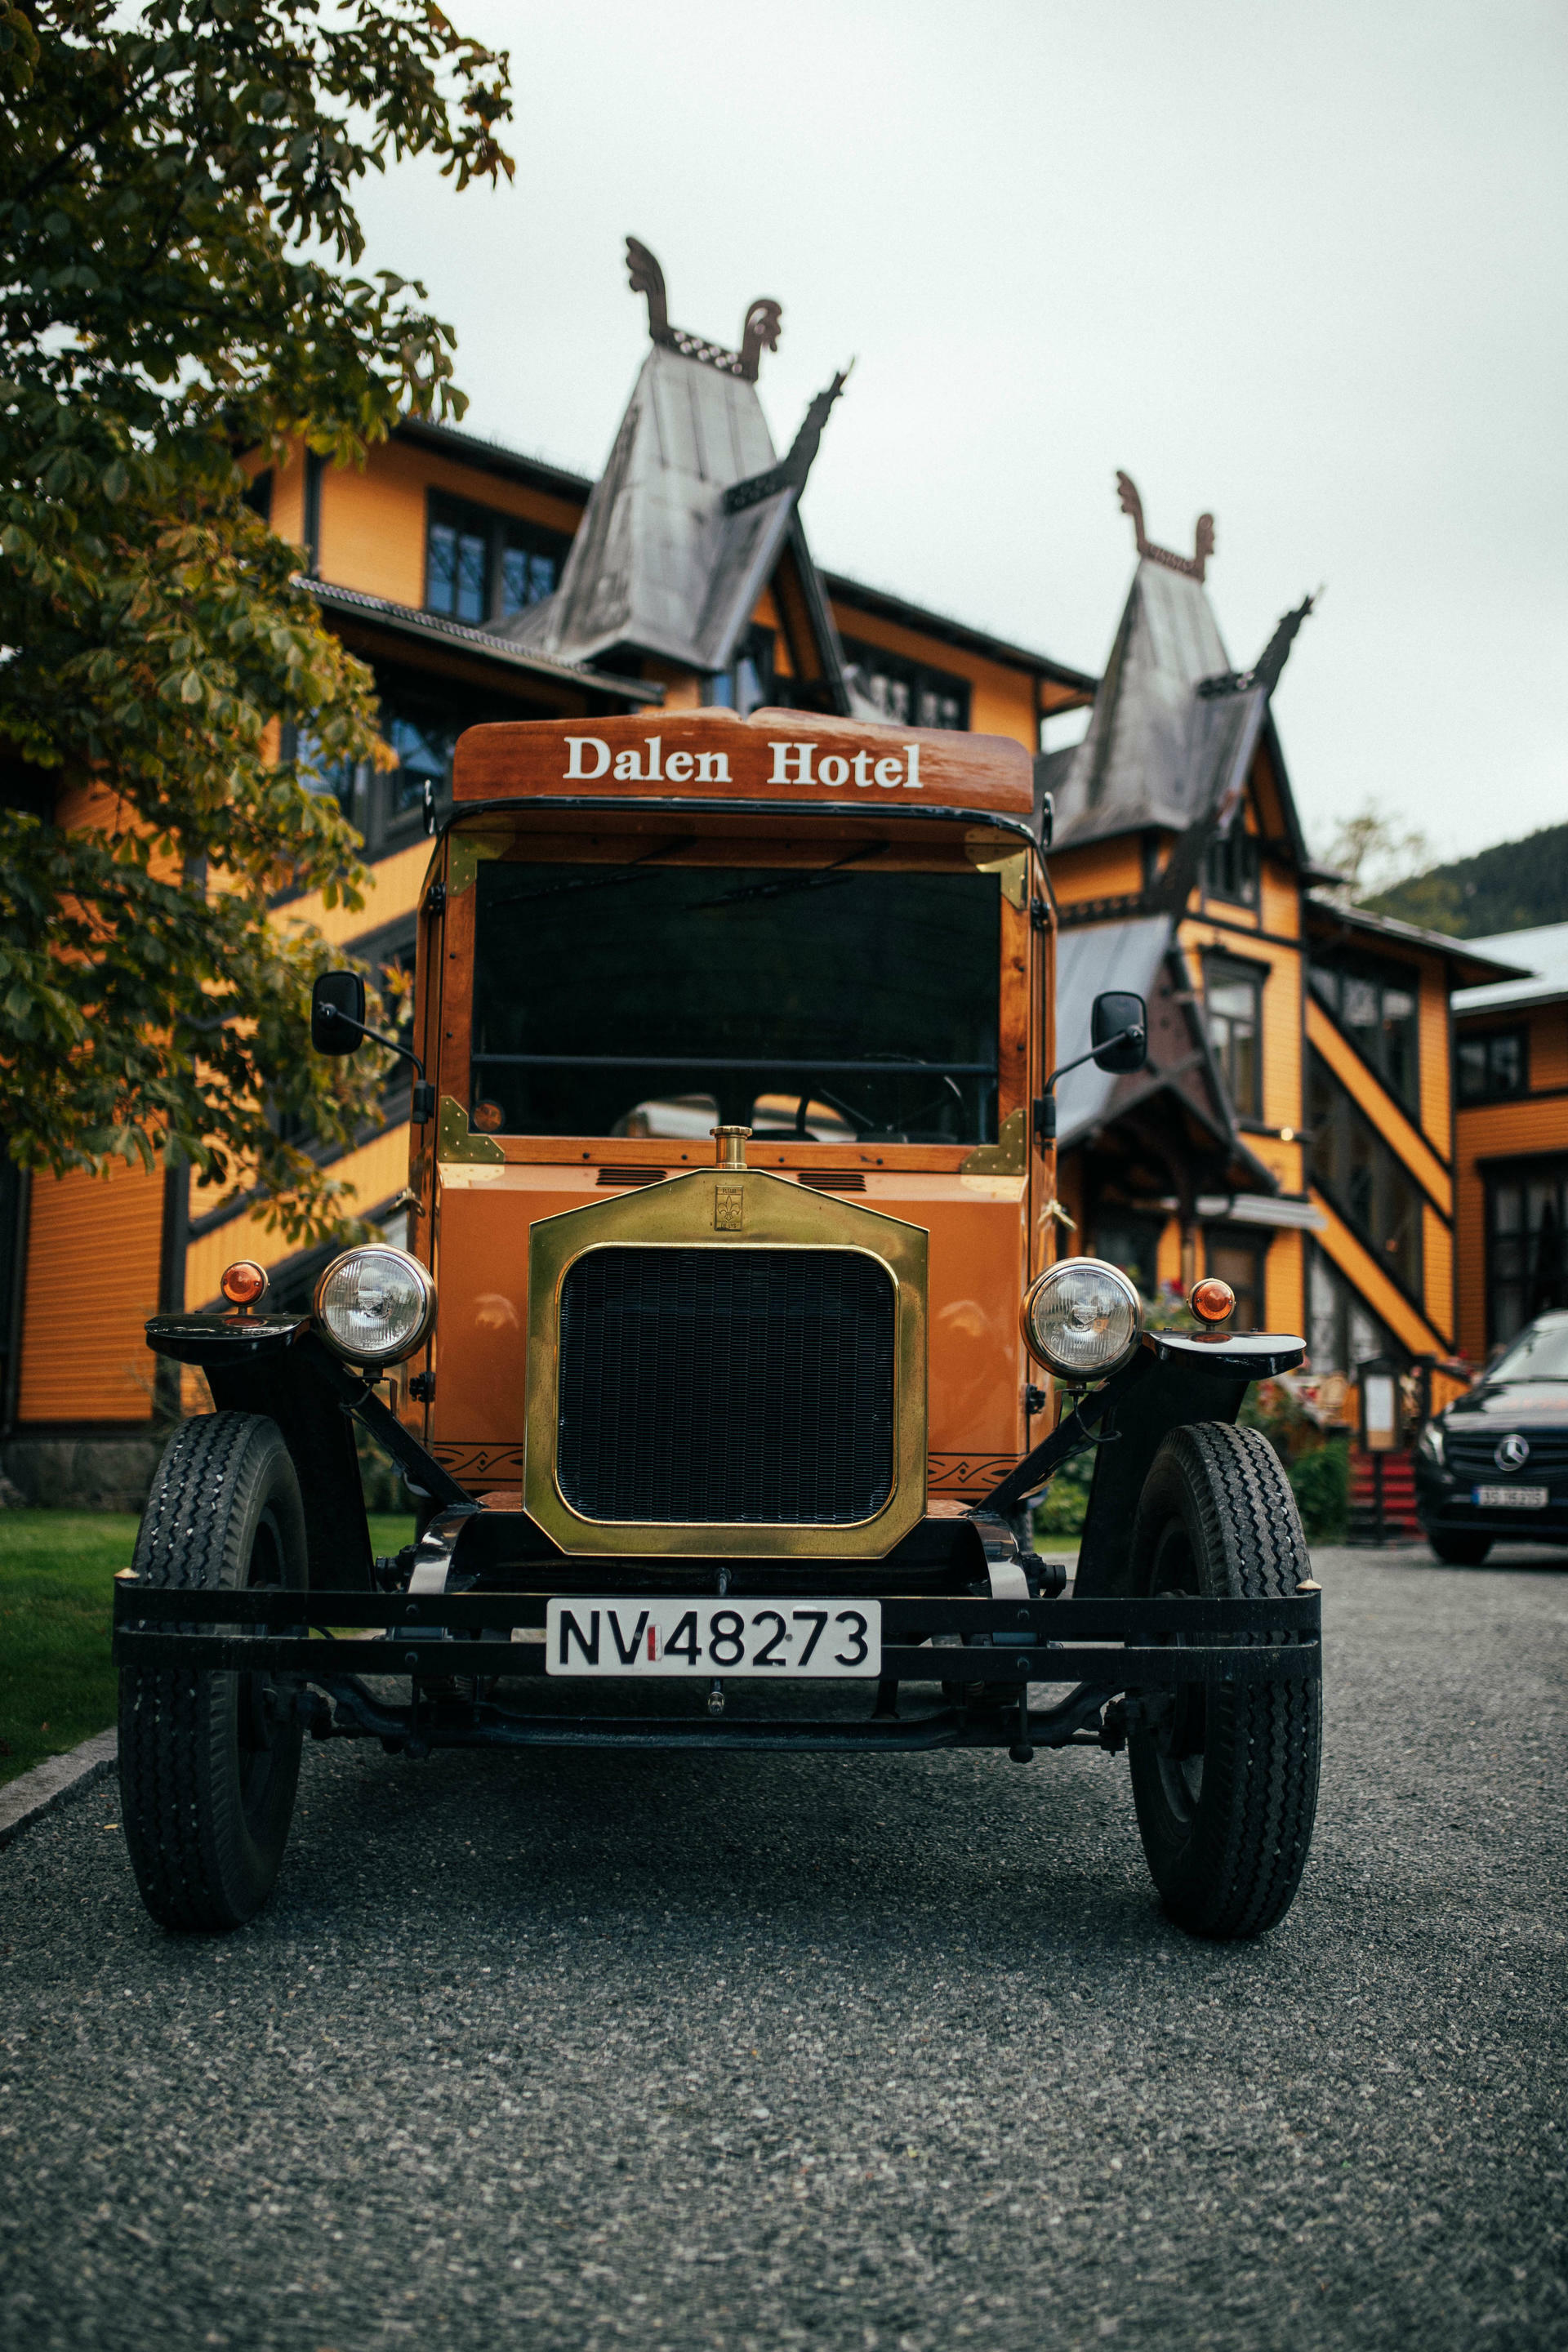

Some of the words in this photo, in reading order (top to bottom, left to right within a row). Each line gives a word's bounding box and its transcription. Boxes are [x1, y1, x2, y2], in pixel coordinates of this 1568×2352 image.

[564, 737, 733, 782] Dalen
[767, 742, 924, 788] Hotel
[559, 1610, 650, 1665] NV
[663, 1610, 868, 1667] 48273
